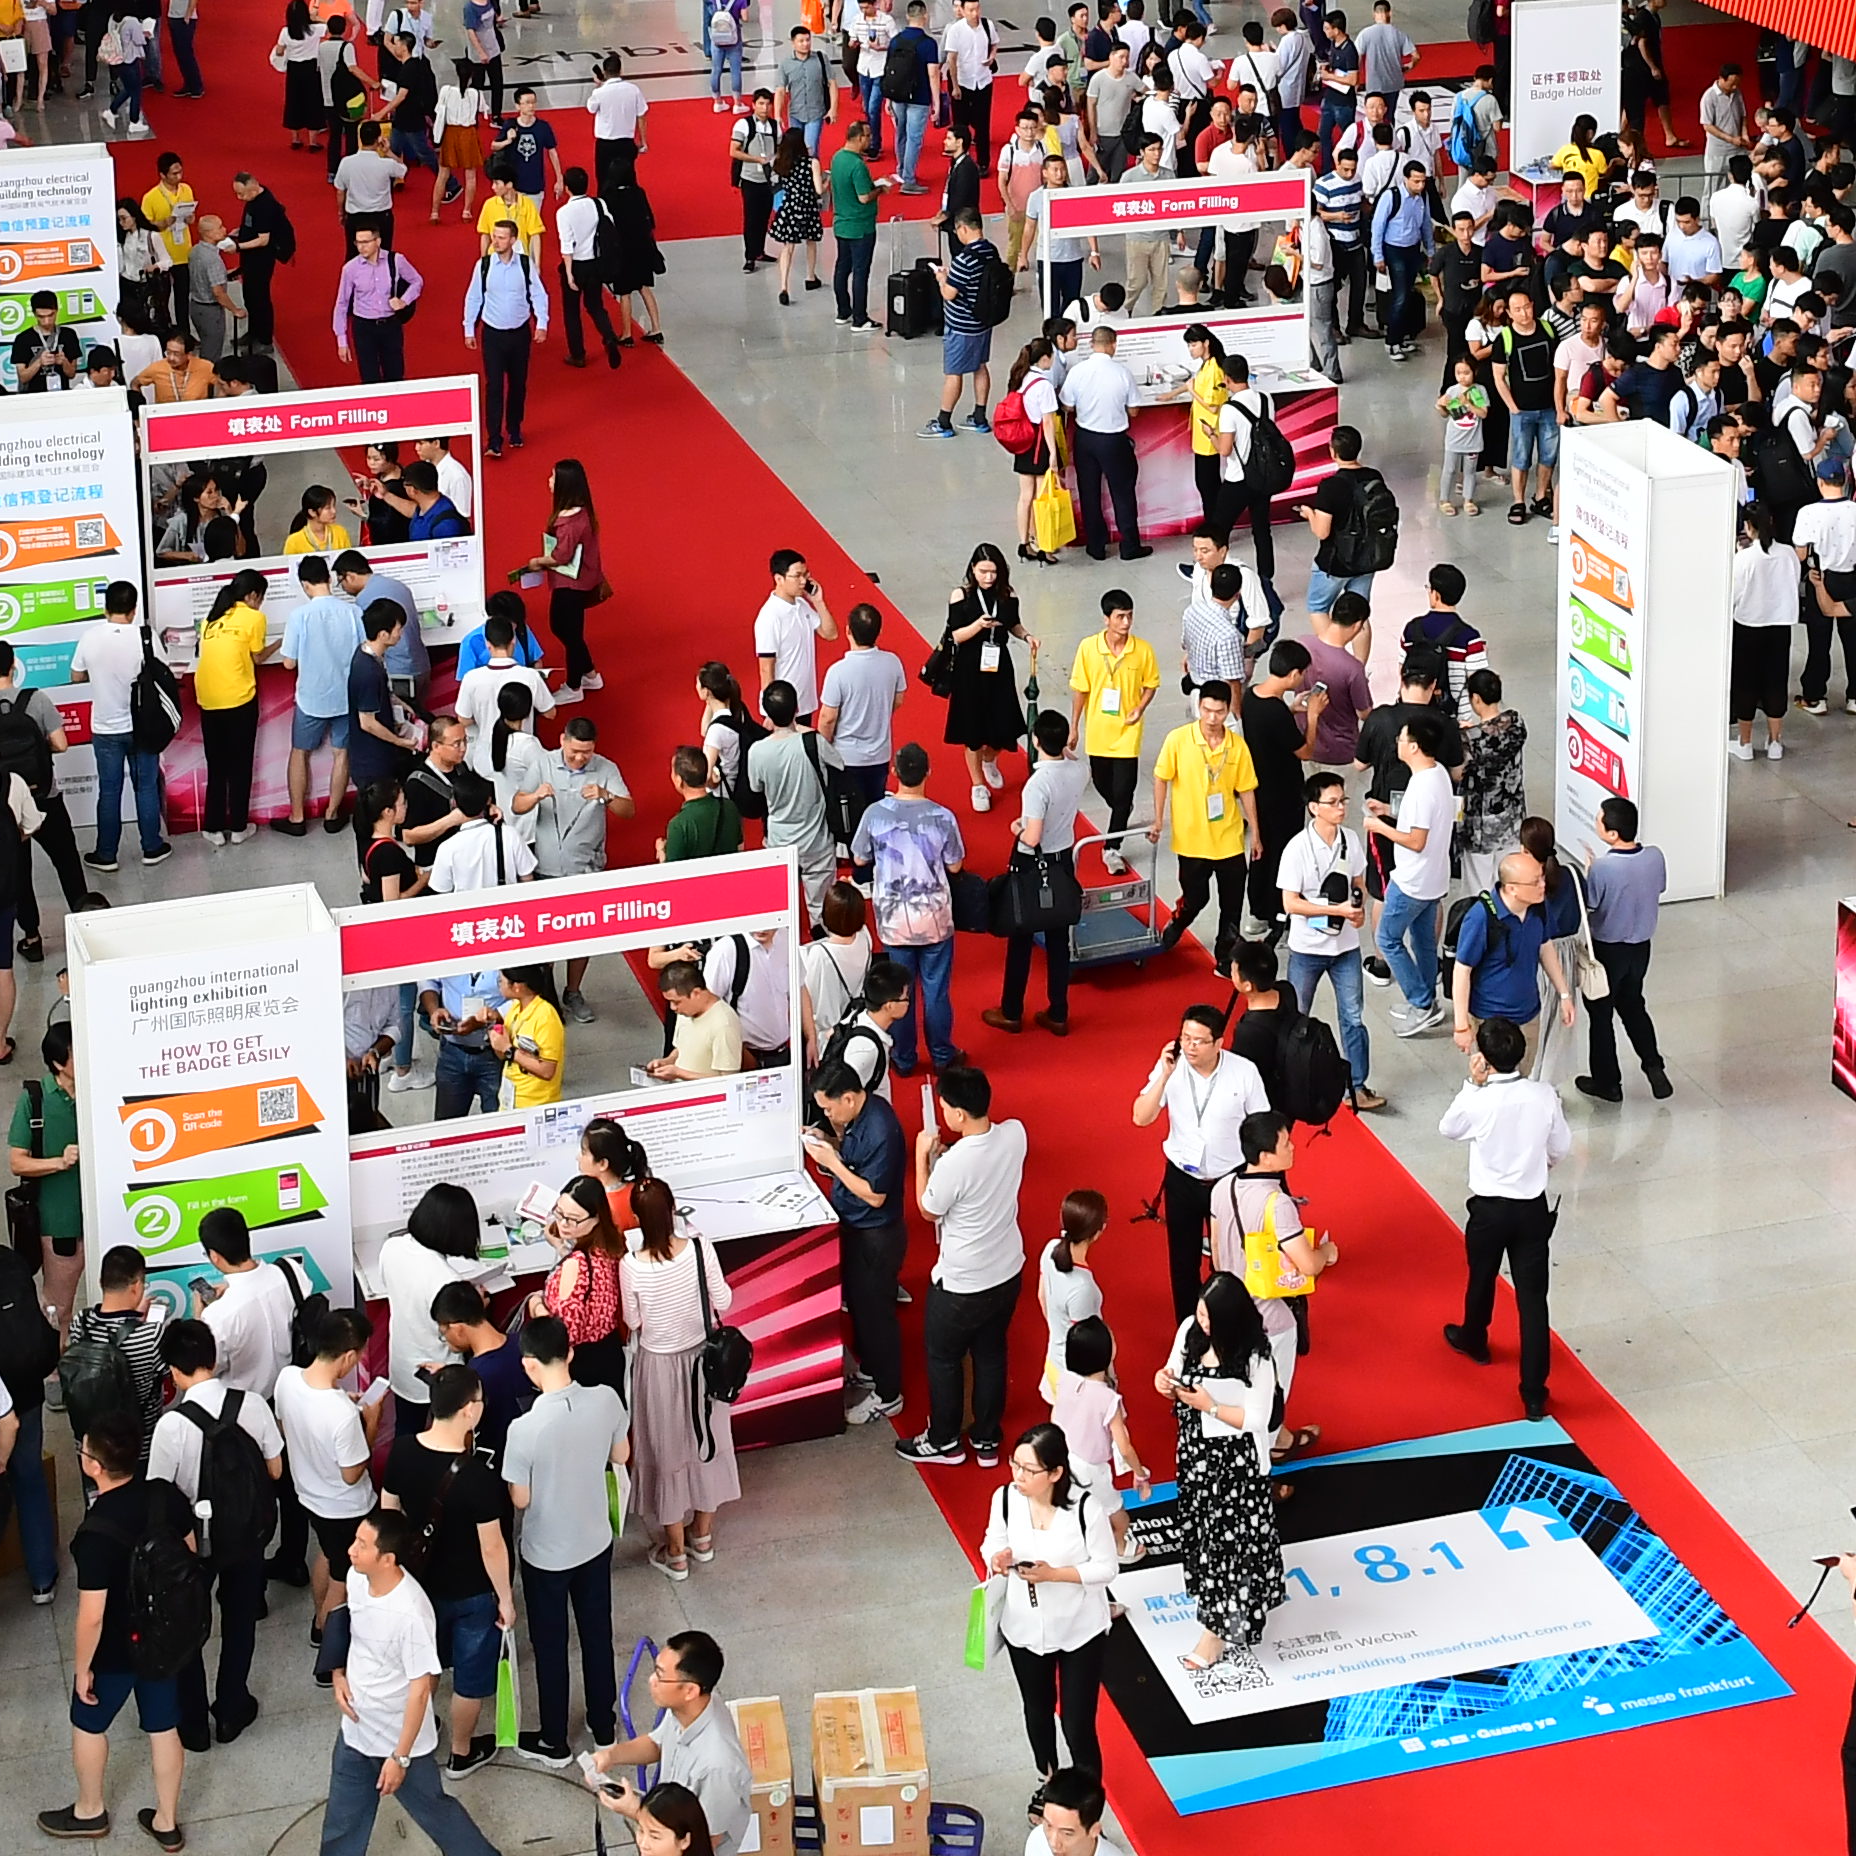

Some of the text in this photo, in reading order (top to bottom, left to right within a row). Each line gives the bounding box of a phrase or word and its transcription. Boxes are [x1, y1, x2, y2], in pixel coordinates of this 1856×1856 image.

[1531, 68, 1603, 86] 证件套领取处
[1530, 85, 1603, 101] Badge Holder
[45, 171, 90, 186] electrical
[36, 184, 93, 199] technology
[1111, 194, 1240, 218] 填表处 Form Filling
[0, 256, 12, 272] 1
[2, 306, 17, 322] 2
[227, 408, 389, 437] 填表处 Form Filling
[45, 430, 102, 448] electrical
[34, 447, 105, 465] technology
[449, 895, 672, 948] 填表处 Form Filling
[128, 958, 300, 999] guangzhou international
[129, 982, 268, 1015] lighting exhibition
[131, 995, 300, 1036] 广州国际照明展览会
[160, 1033, 264, 1062] HOW TO GET
[138, 1045, 291, 1081] THE BADGE EASILY
[182, 1107, 224, 1123] Scan the
[182, 1116, 224, 1133] QR-code
[138, 1118, 157, 1151] 1
[187, 1199, 201, 1211] Fill
[228, 1193, 250, 1206] form
[141, 1206, 167, 1237] 2
[1353, 1540, 1465, 1584] 8.1
[1271, 1629, 1343, 1653] 关注微信
[1277, 1628, 1419, 1663] Follow on WeChat
[1291, 1618, 1594, 1684] www.building.messefrankfurt.com.cn
[1620, 1674, 1756, 1712] messe frankfurt
[1537, 1715, 1557, 1732] ya
